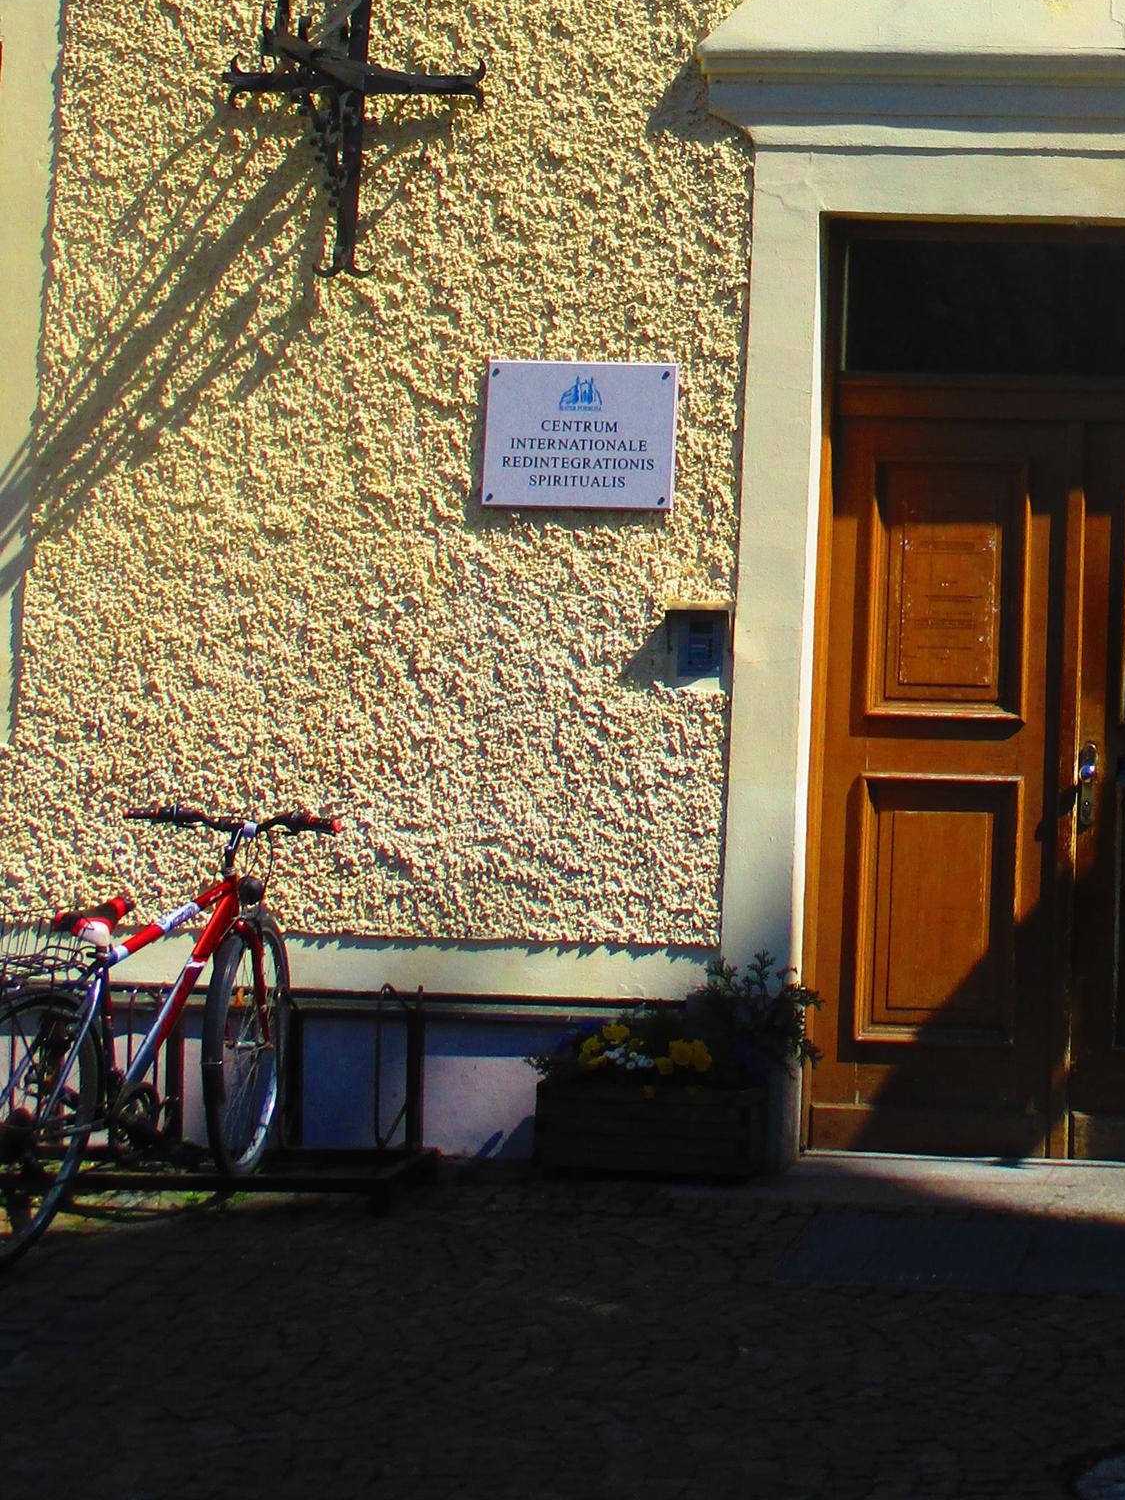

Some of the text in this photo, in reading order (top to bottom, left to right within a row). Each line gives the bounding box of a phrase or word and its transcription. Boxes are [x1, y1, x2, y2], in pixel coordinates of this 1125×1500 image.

[540, 419, 618, 434] CENTRUM
[510, 437, 648, 452] INTERNATIONALE
[502, 455, 655, 471] REDINTEGRATIONIS
[528, 474, 626, 488] SPIRITUALIS
